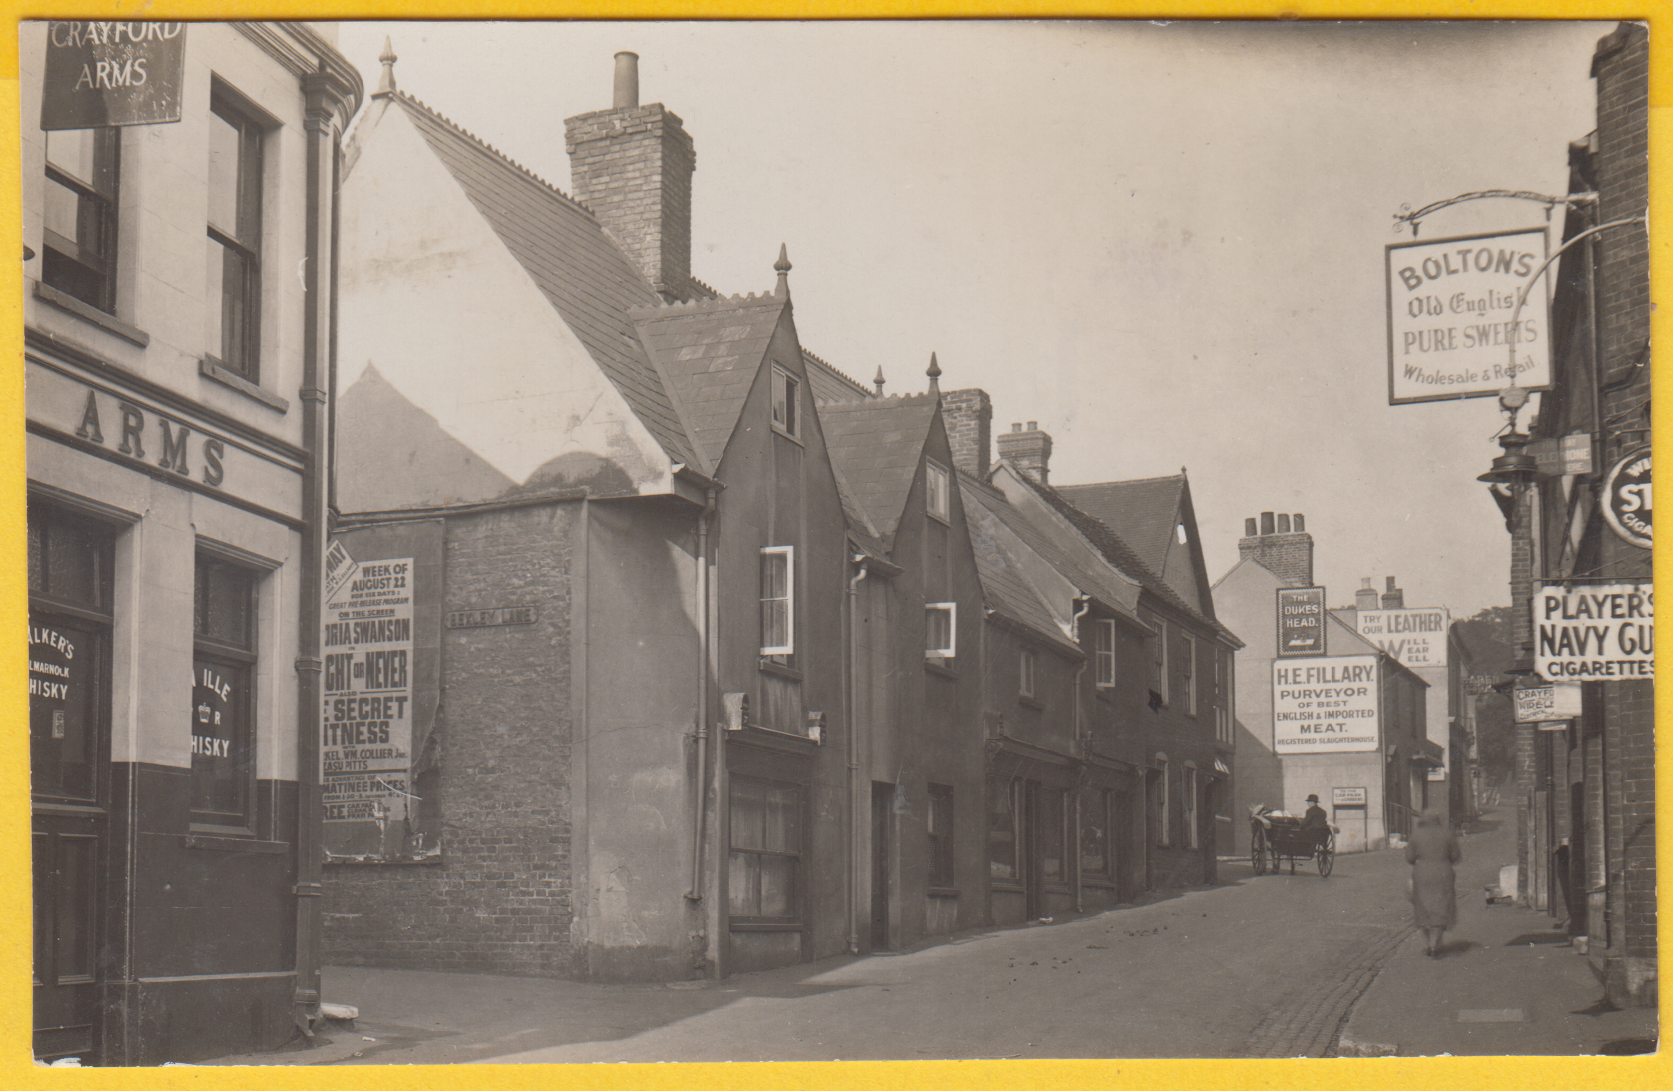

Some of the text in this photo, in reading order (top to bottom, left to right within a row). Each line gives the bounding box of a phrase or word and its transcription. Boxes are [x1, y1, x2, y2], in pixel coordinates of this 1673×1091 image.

[52, 22, 182, 48] CRAYFORD
[75, 58, 147, 90] ARMS
[1398, 247, 1536, 292] BOLTON'S
[1408, 295, 1443, 318] Old
[1403, 327, 1458, 355] PURE
[1404, 363, 1478, 385] Wholesale
[1482, 369, 1491, 381] &
[75, 390, 224, 486] ARMS
[326, 543, 346, 581] WAY
[362, 563, 408, 578] WEEK OF
[351, 577, 392, 592] AUGUST
[394, 576, 406, 588] 22
[328, 601, 347, 609] GREAT
[1284, 603, 1319, 615] DUKE'S
[1292, 594, 1309, 602] THE
[353, 618, 410, 644] SWANSON
[1286, 617, 1319, 628] HEAD.
[1362, 625, 1383, 635] OUR
[1363, 612, 1443, 634] TRY LEATHER
[1540, 624, 1610, 657] NAVY
[353, 662, 364, 678] OR
[365, 650, 407, 689] NEVER
[29, 678, 68, 700] HISKY
[1280, 687, 1368, 700] PURVEYOR
[333, 696, 408, 722] SECRET
[1277, 709, 1374, 721] ENGLISH & IMPORTED
[1317, 700, 1349, 708] BEST
[214, 711, 221, 725] R
[1300, 723, 1348, 734] MEAT.
[191, 735, 230, 758] HISKY
[360, 748, 393, 759] COLLIER
[346, 760, 368, 770] PITTS
